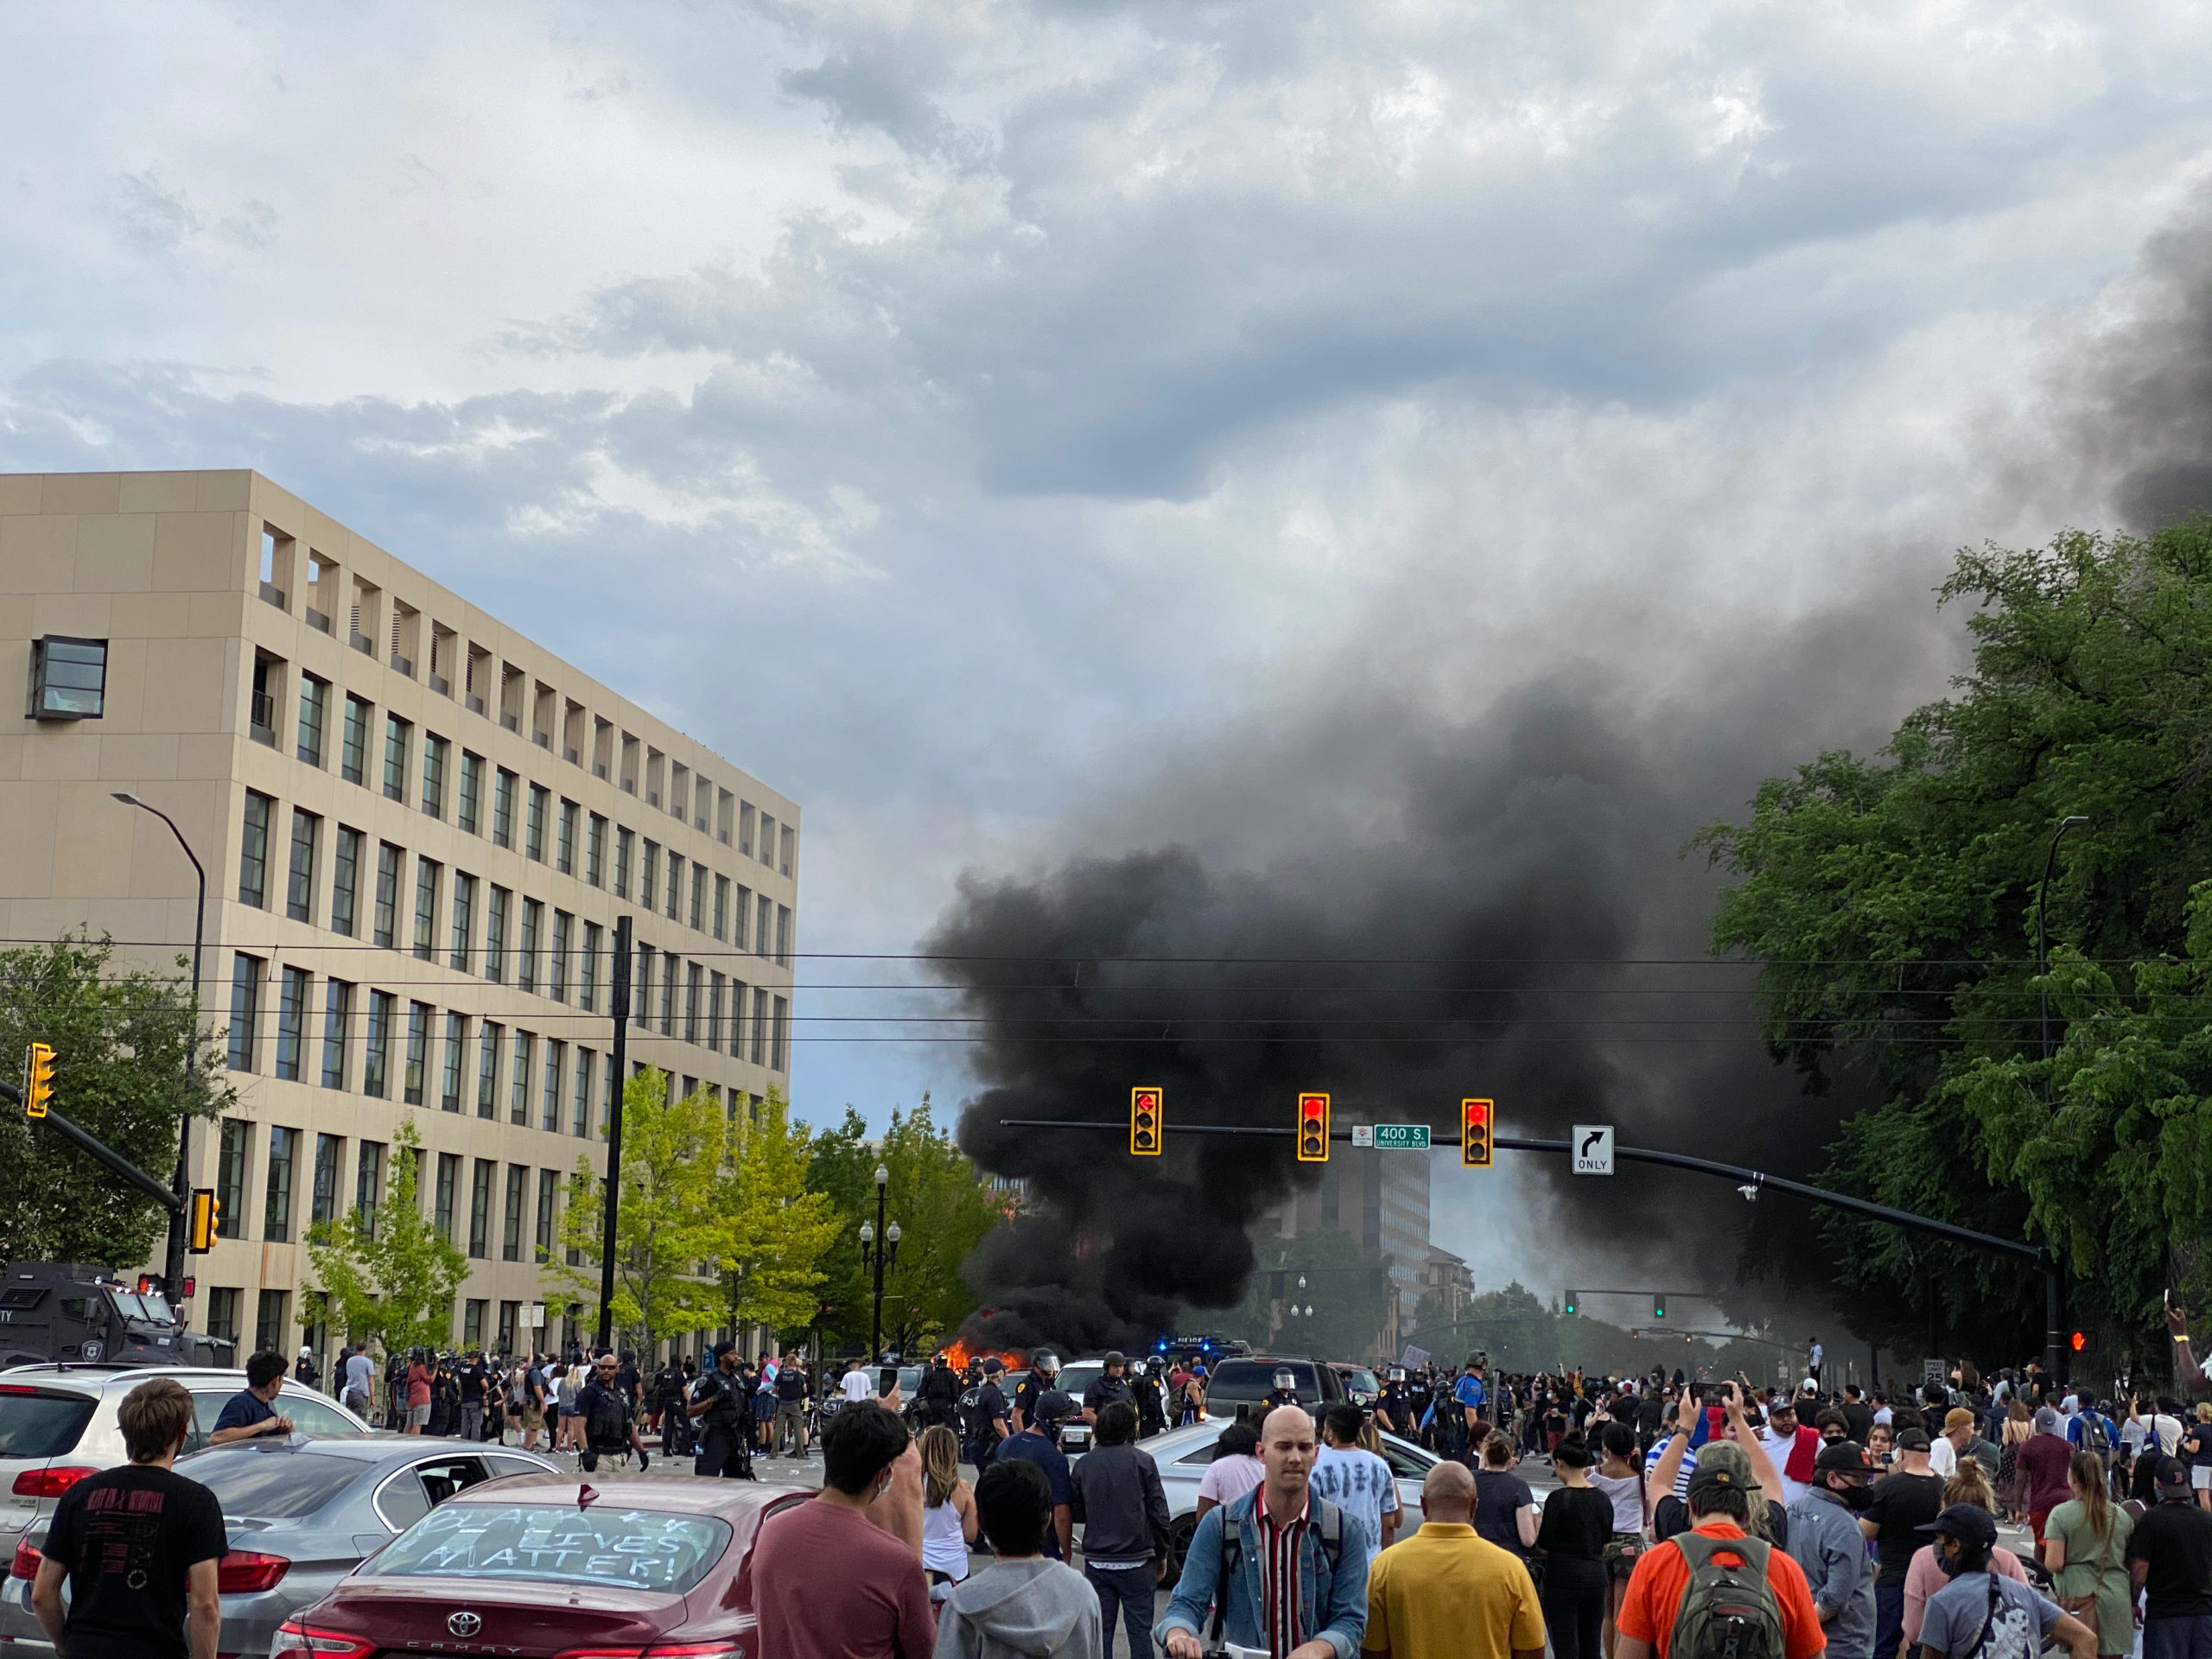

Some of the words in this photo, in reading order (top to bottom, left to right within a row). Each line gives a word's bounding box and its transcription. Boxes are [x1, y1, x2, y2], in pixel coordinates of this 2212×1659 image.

[1381, 1128, 1407, 1140] 400
[1413, 1128, 1424, 1141] S.
[1579, 1160, 1607, 1170] ONLY
[1927, 1373, 1943, 1383] 25
[418, 1510, 592, 1536] BLACK
[518, 1529, 680, 1554] LIVES
[418, 1546, 675, 1582] MATTER!
[407, 1642, 521, 1654] CAMRY
